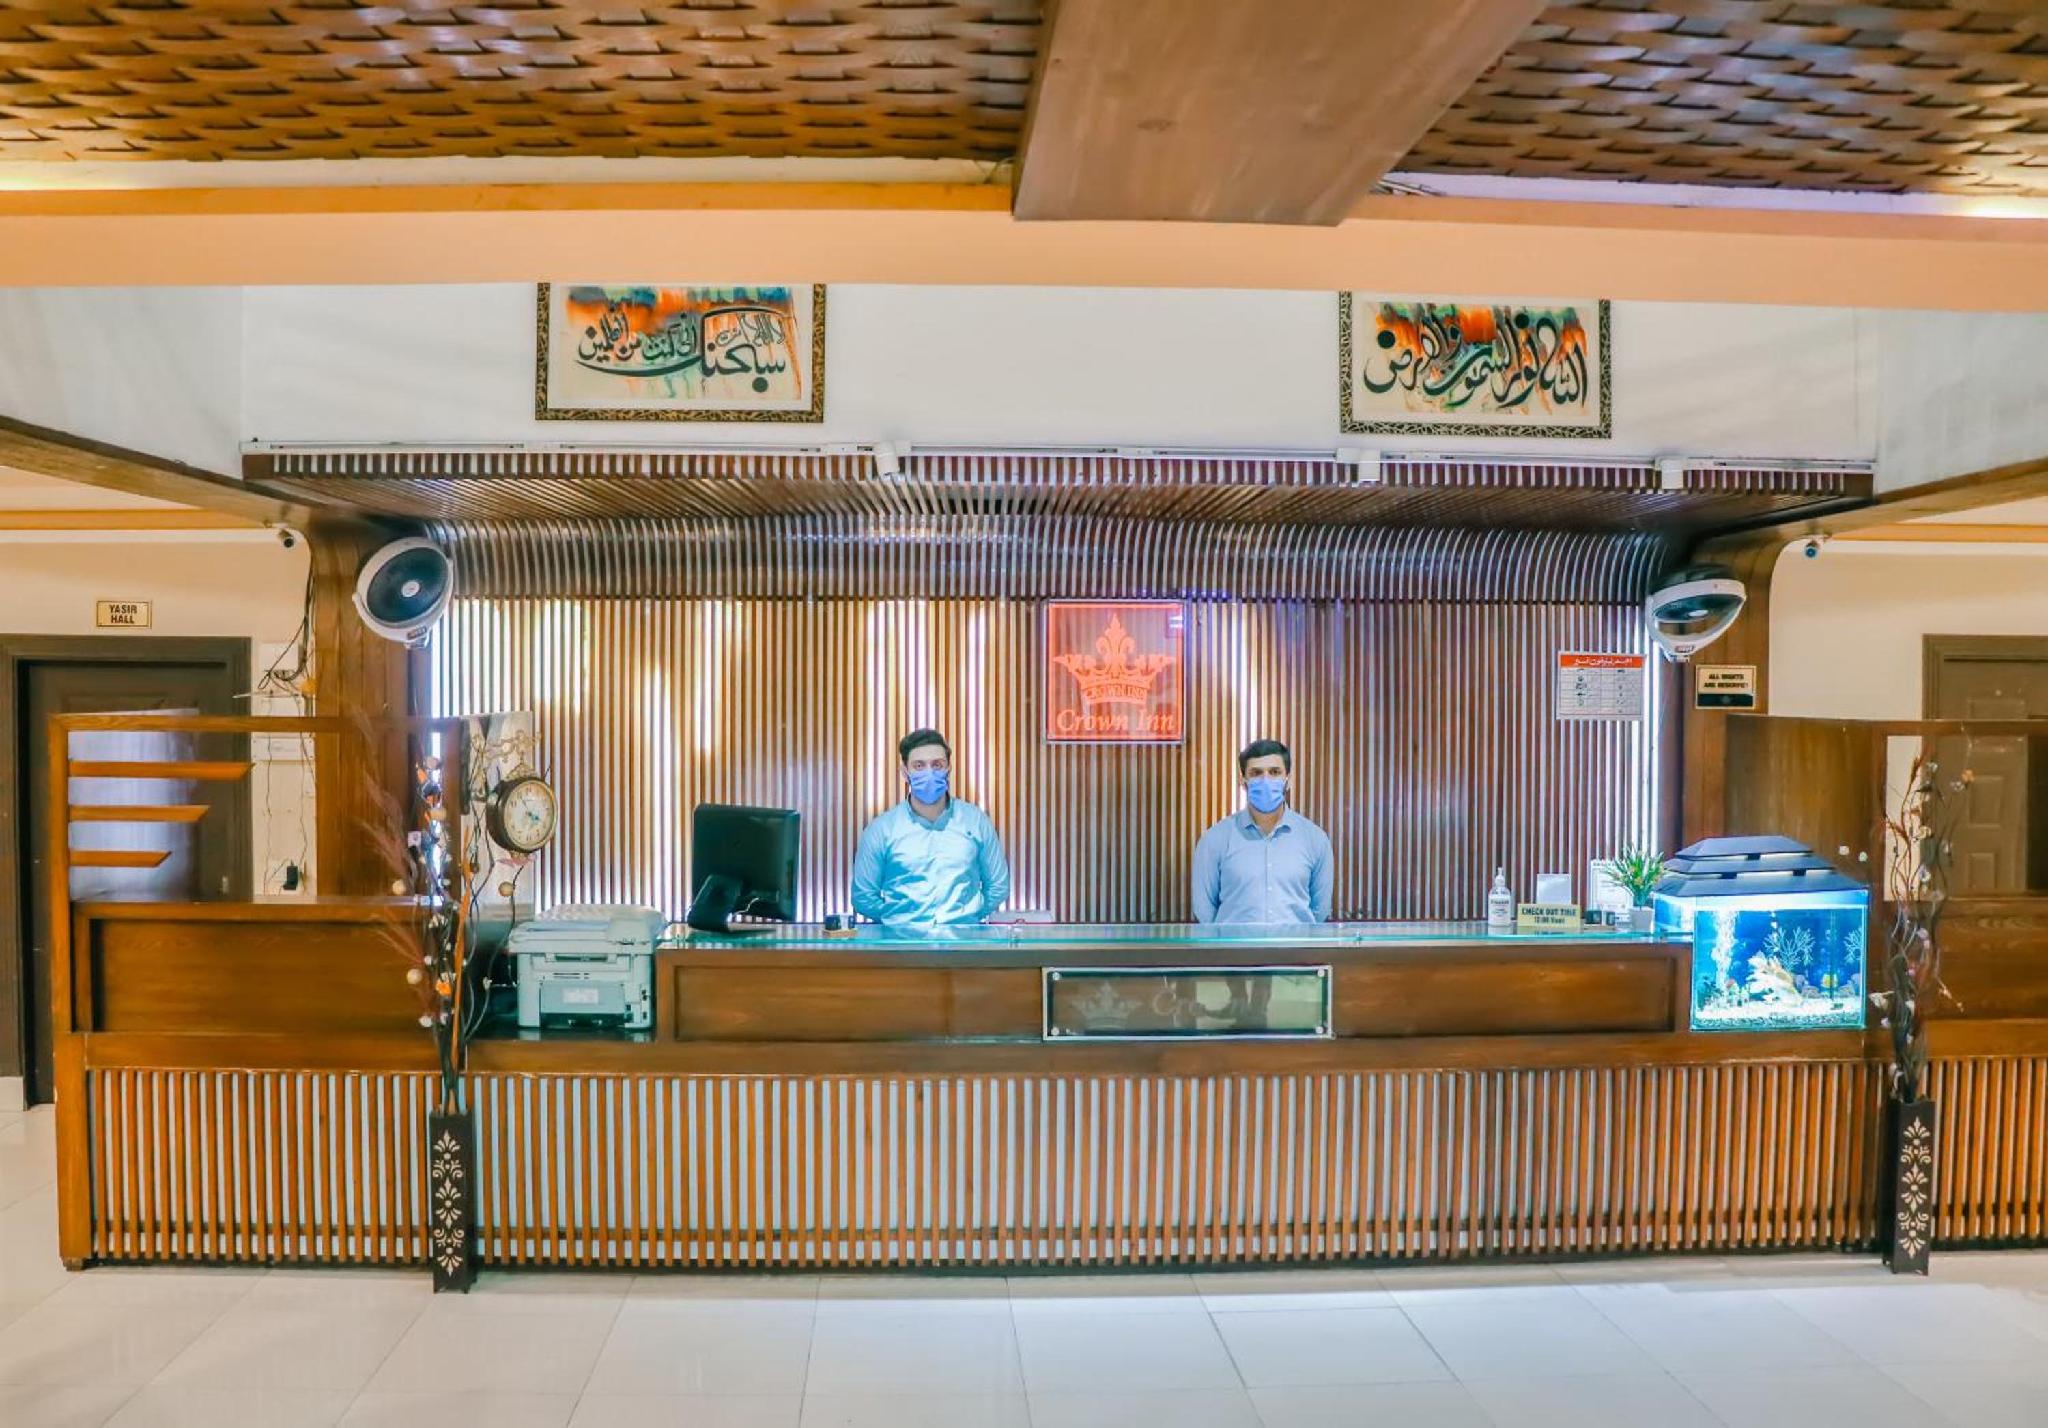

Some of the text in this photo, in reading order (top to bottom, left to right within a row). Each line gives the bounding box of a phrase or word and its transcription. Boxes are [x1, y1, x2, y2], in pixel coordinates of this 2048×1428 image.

[109, 604, 138, 614] YASIR
[110, 615, 135, 624] HALL
[1057, 708, 1174, 731] Crown Inn
[1521, 907, 1577, 917] CHECK OUT TIME
